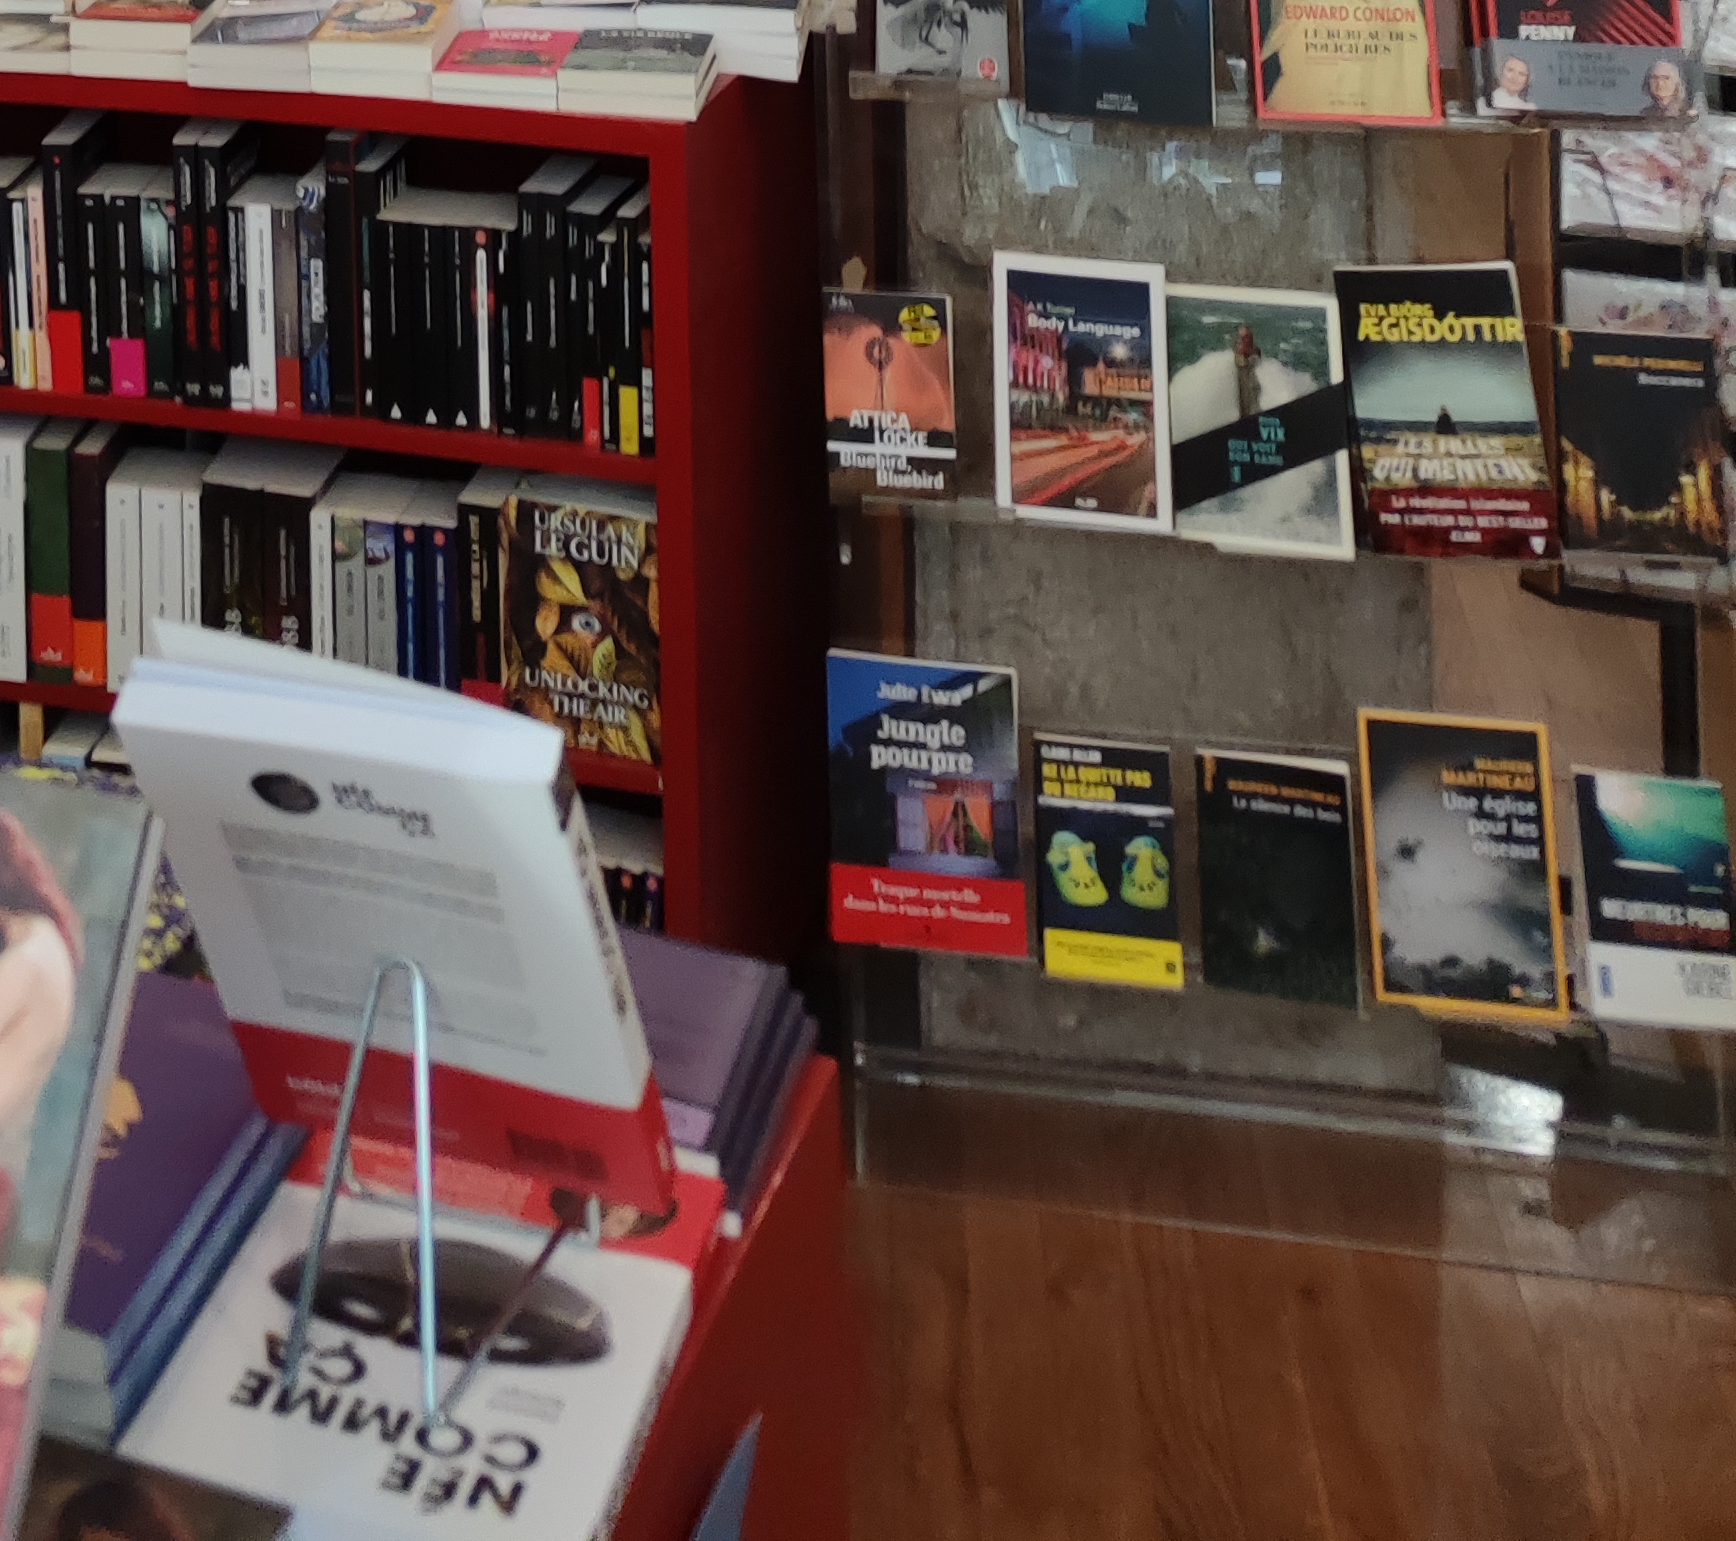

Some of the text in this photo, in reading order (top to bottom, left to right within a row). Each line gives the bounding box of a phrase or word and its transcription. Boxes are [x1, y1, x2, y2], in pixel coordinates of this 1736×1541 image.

[1285, 5, 1417, 23] EDWARD CONLON
[1518, 24, 1576, 41] PENNY
[1027, 315, 1142, 338] Body Language
[1358, 312, 1525, 343] ÆGISDÓTTIR
[849, 410, 911, 430] ATTICA
[874, 428, 928, 448] LOCKE
[839, 448, 912, 472] Bluebird,
[1373, 457, 1539, 482] QUI MENTENT
[876, 467, 945, 490] Bluebird
[533, 508, 615, 541] URSULA
[534, 529, 639, 570] LE GUIN
[524, 666, 650, 710] UNLOCKING
[552, 693, 627, 725] THE AIR
[877, 713, 966, 749] Jungle
[870, 743, 974, 776] pourpre
[1440, 767, 1536, 793] MARTINEAU
[1441, 790, 1539, 819] Une église
[1468, 816, 1540, 841] pour les
[230, 1365, 541, 1474] COMME
[378, 1453, 526, 1519] NÉE
